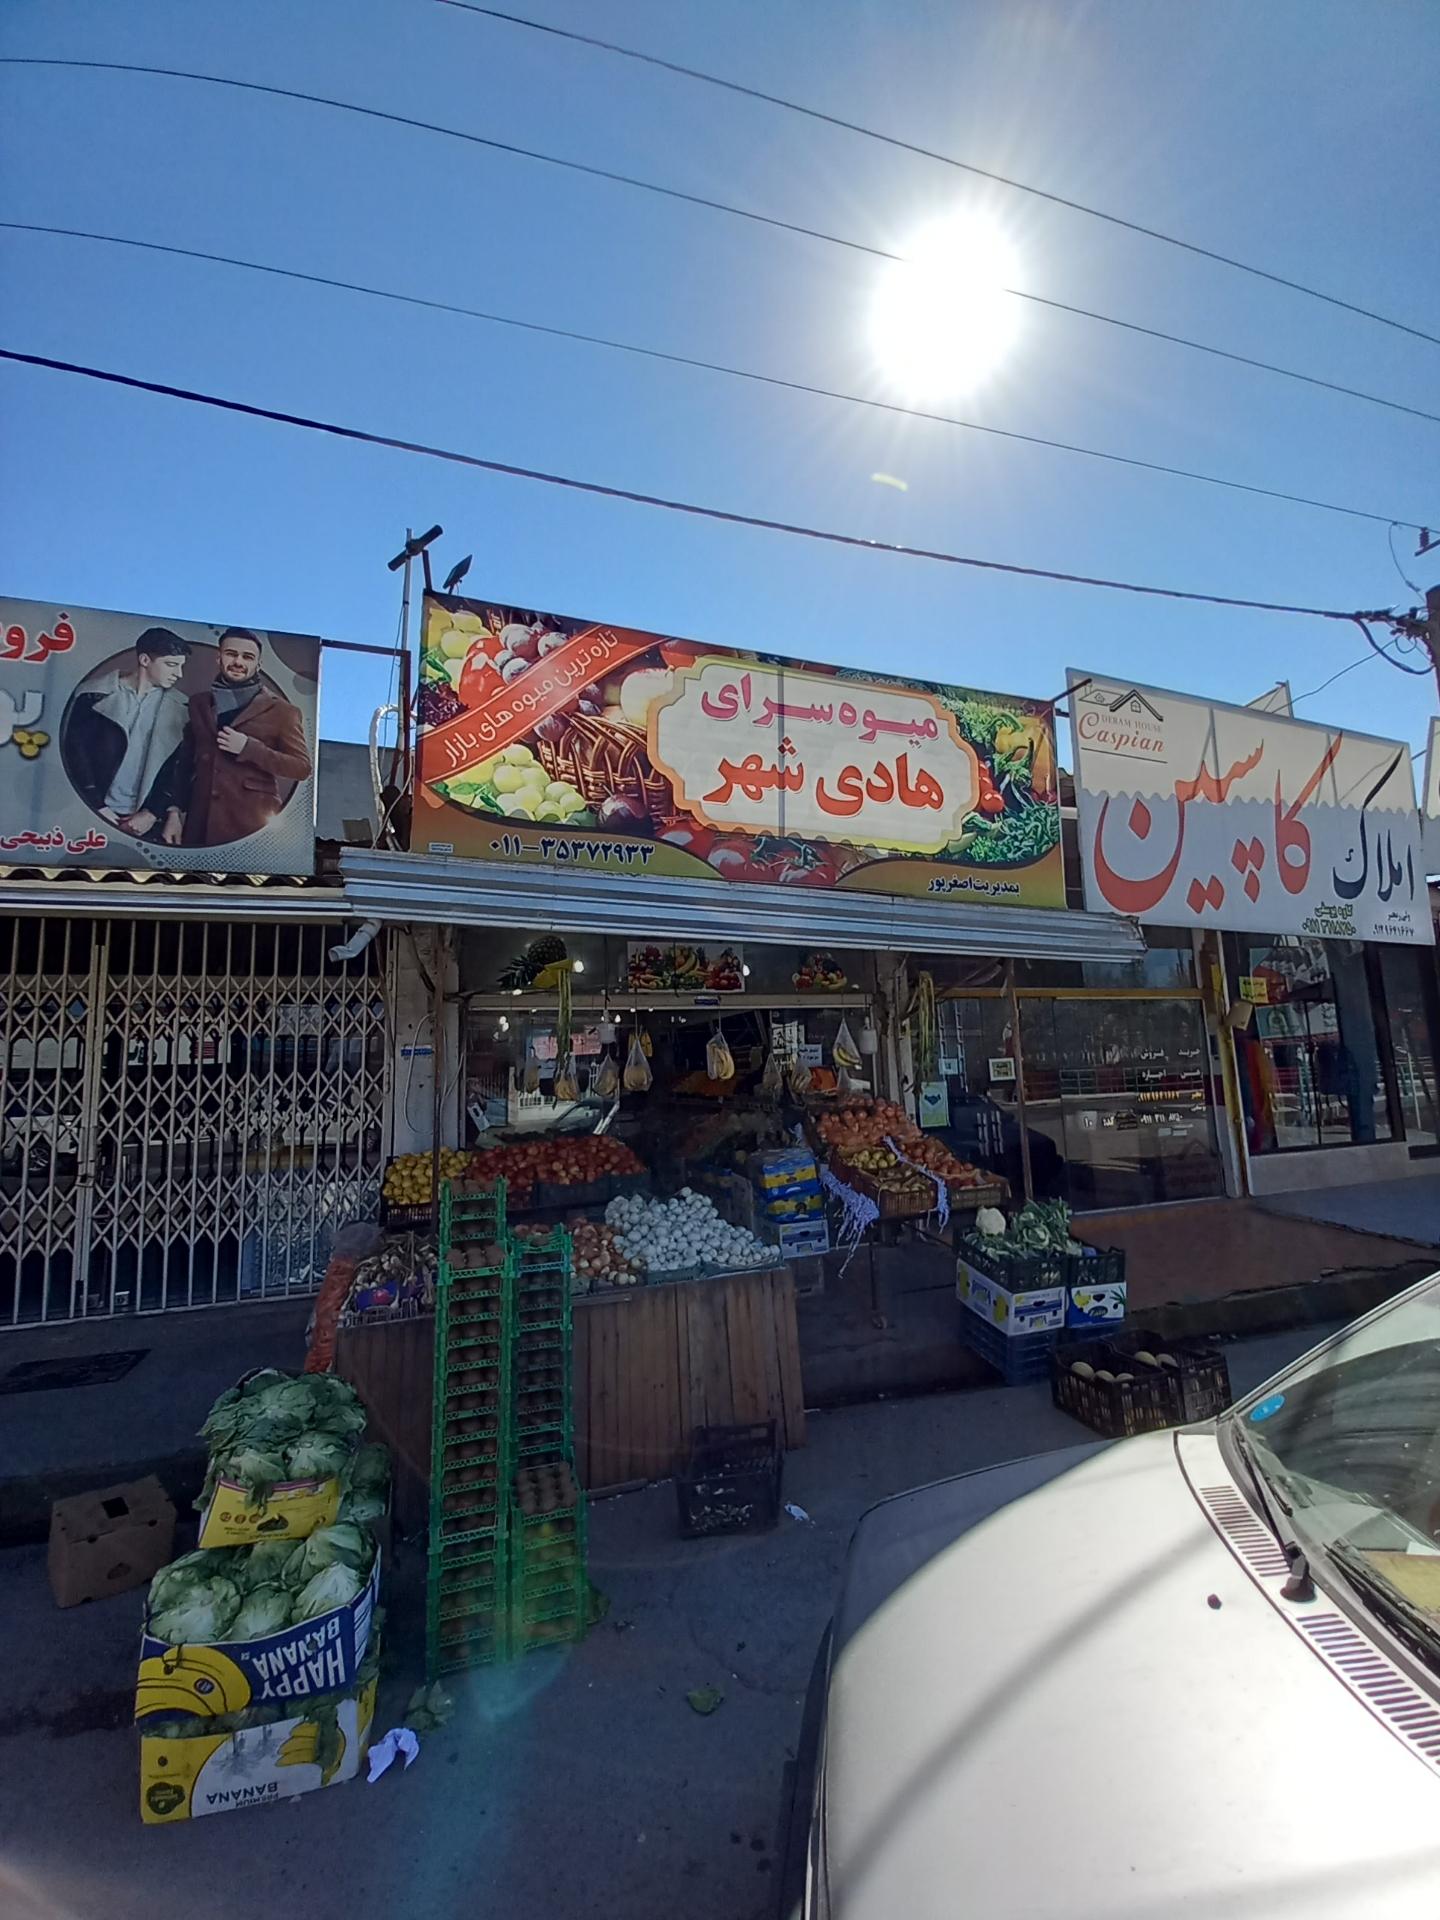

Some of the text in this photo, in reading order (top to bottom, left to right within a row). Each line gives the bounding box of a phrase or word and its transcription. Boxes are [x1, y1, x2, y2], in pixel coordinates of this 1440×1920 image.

[0, 612, 75, 663] فرو
[444, 631, 618, 767] تازه ترین میوه های بازار
[701, 673, 939, 748] میوه سرای
[1079, 712, 1164, 752] Caspian
[703, 736, 944, 817] هادی شهر
[0, 826, 107, 855] علی ذبیحی
[1094, 730, 1343, 914] کاسپین
[927, 873, 973, 894] اصغرپور
[1141, 1068, 1166, 1081] اجاره
[260, 1637, 346, 1700] HAPPY
[206, 1781, 278, 1804] BANANA
[236, 1793, 279, 1808] PREMIUM
